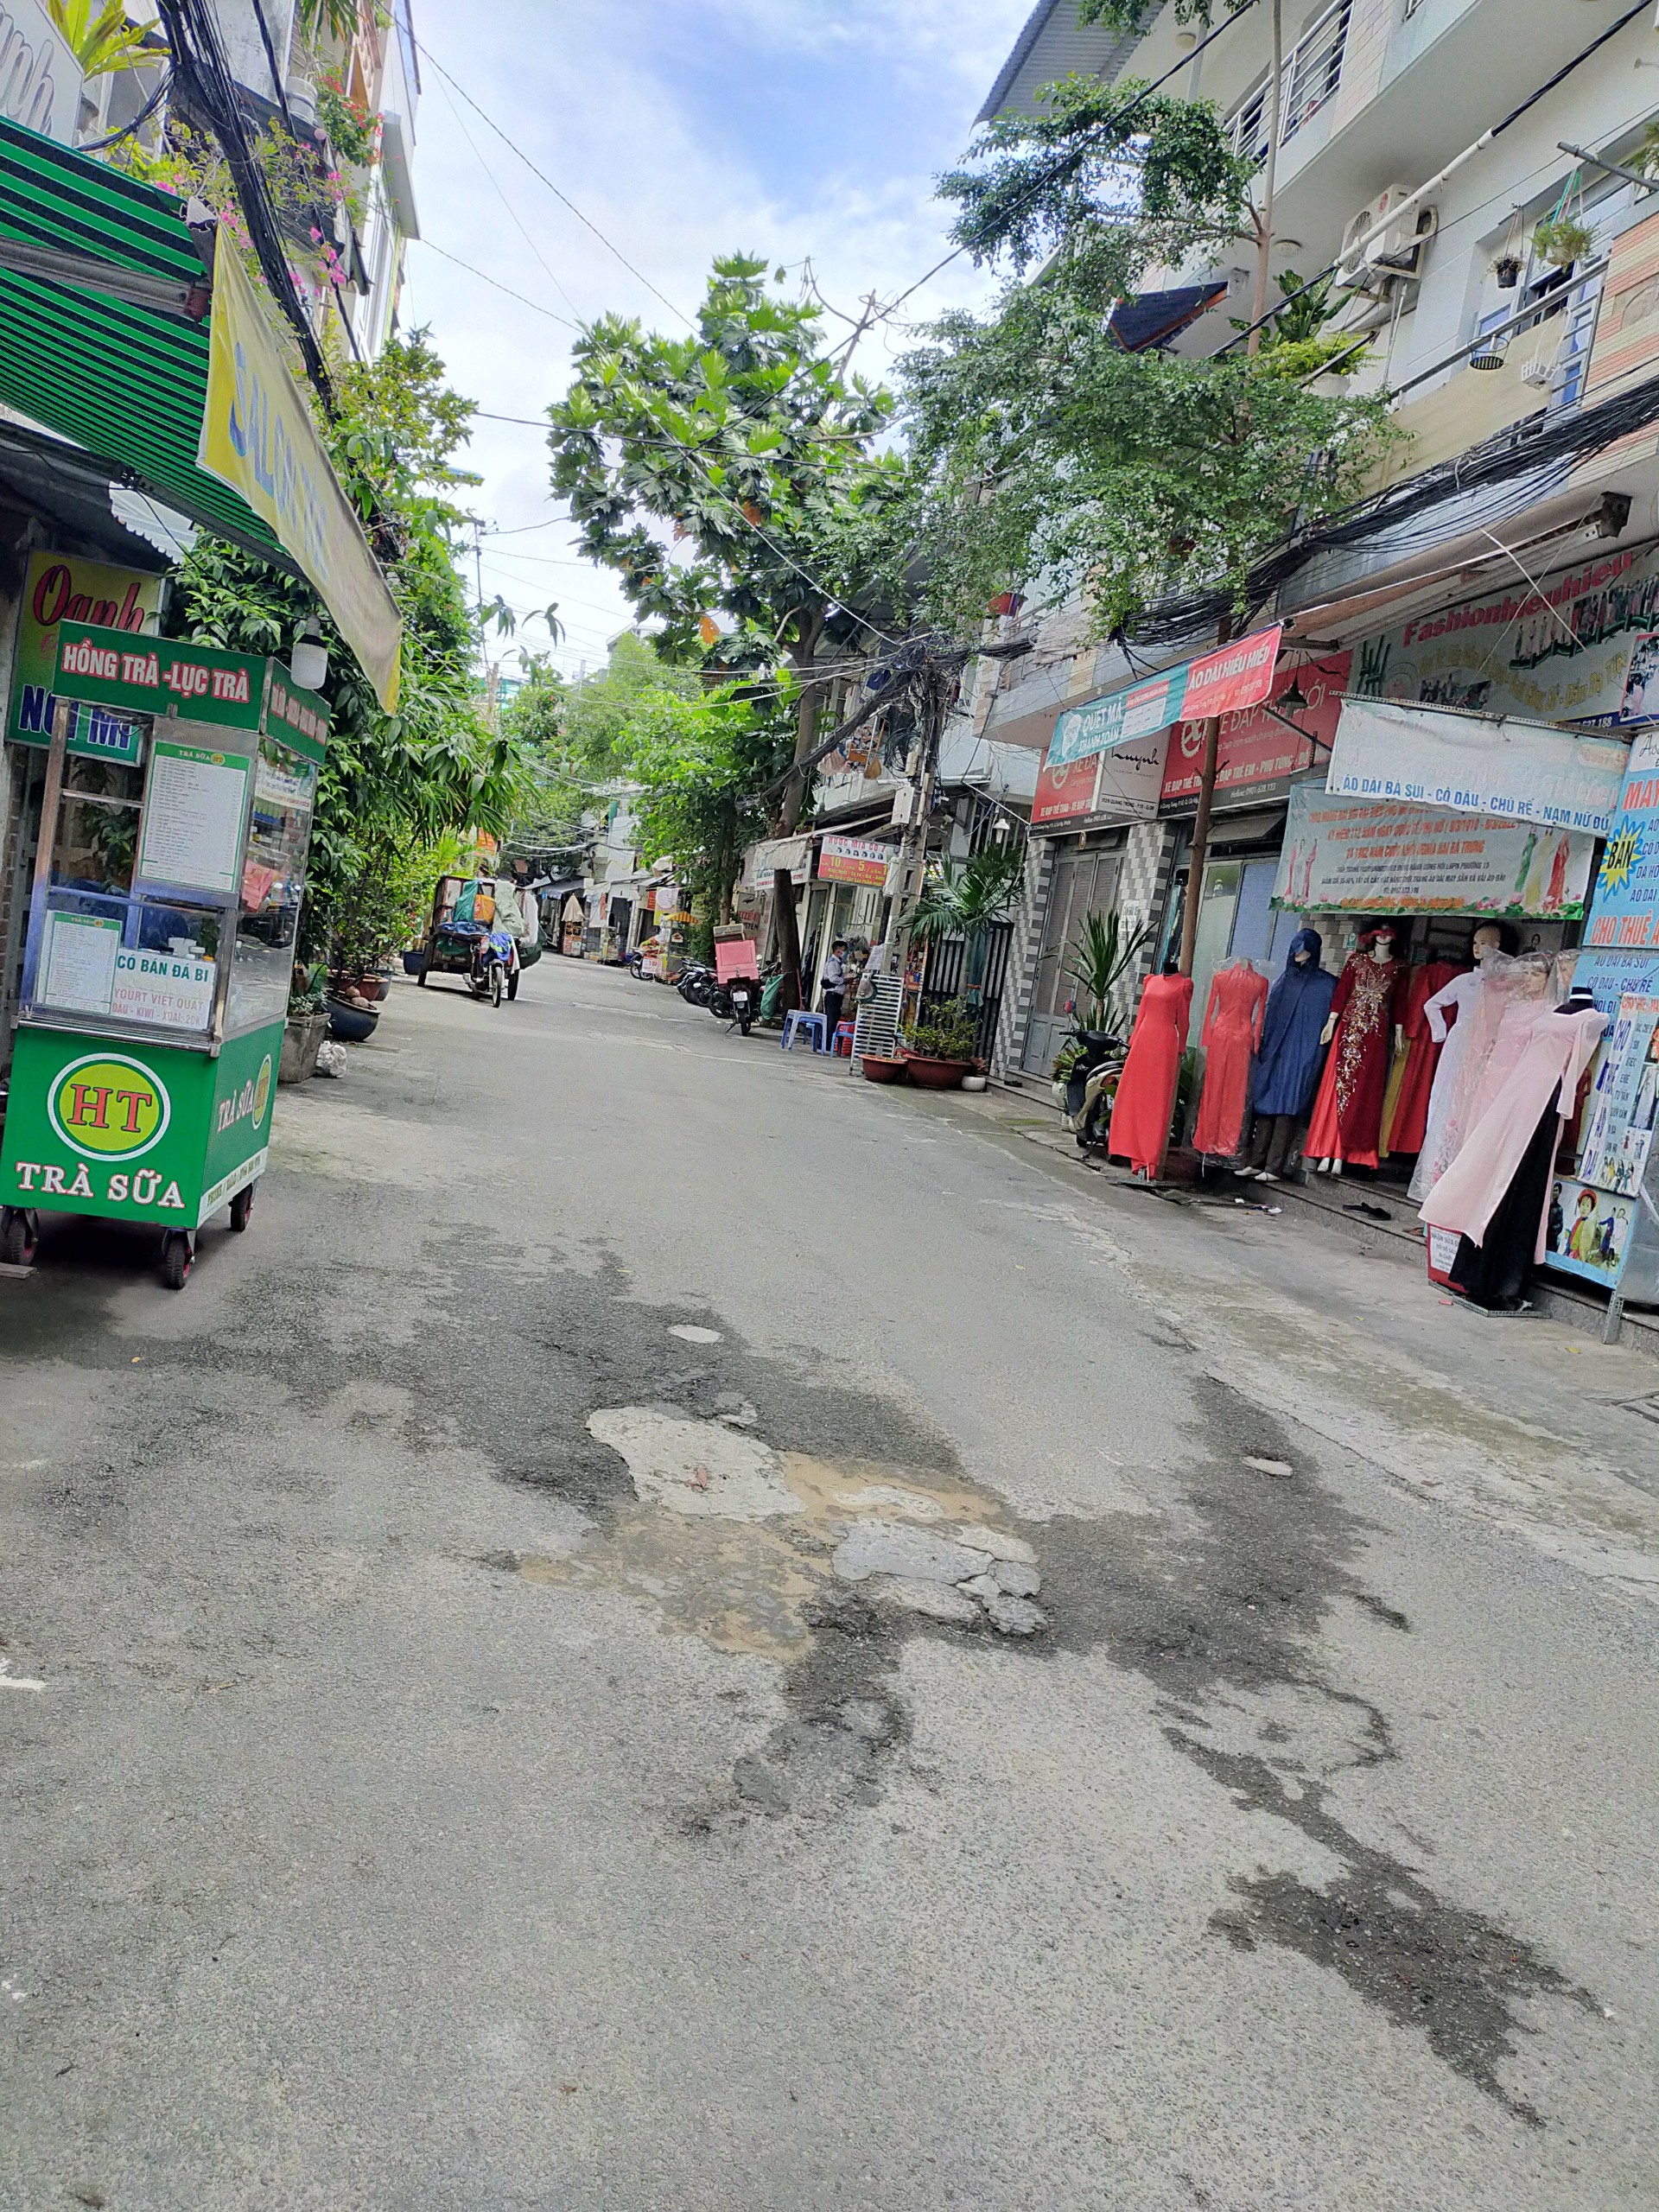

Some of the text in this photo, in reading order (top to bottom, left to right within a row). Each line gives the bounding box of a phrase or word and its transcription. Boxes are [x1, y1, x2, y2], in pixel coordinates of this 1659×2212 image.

[62, 639, 119, 678] HỒNG
[123, 653, 159, 685] TRÀ
[213, 670, 250, 702] TRÀ
[1343, 774, 1610, 831] ÁO DÀI BÀ SUI CÔ DÂU CHÚ RỂ NAM NỮ ĐỦ
[1606, 833, 1636, 870] BÁN
[1590, 916, 1618, 947] CHO
[1617, 909, 1654, 947] THUÊ
[117, 953, 209, 982] CÓ BÁN ĐÁ BI
[67, 1083, 153, 1134] HT
[15, 1160, 186, 1209] TRÀ SỮA
